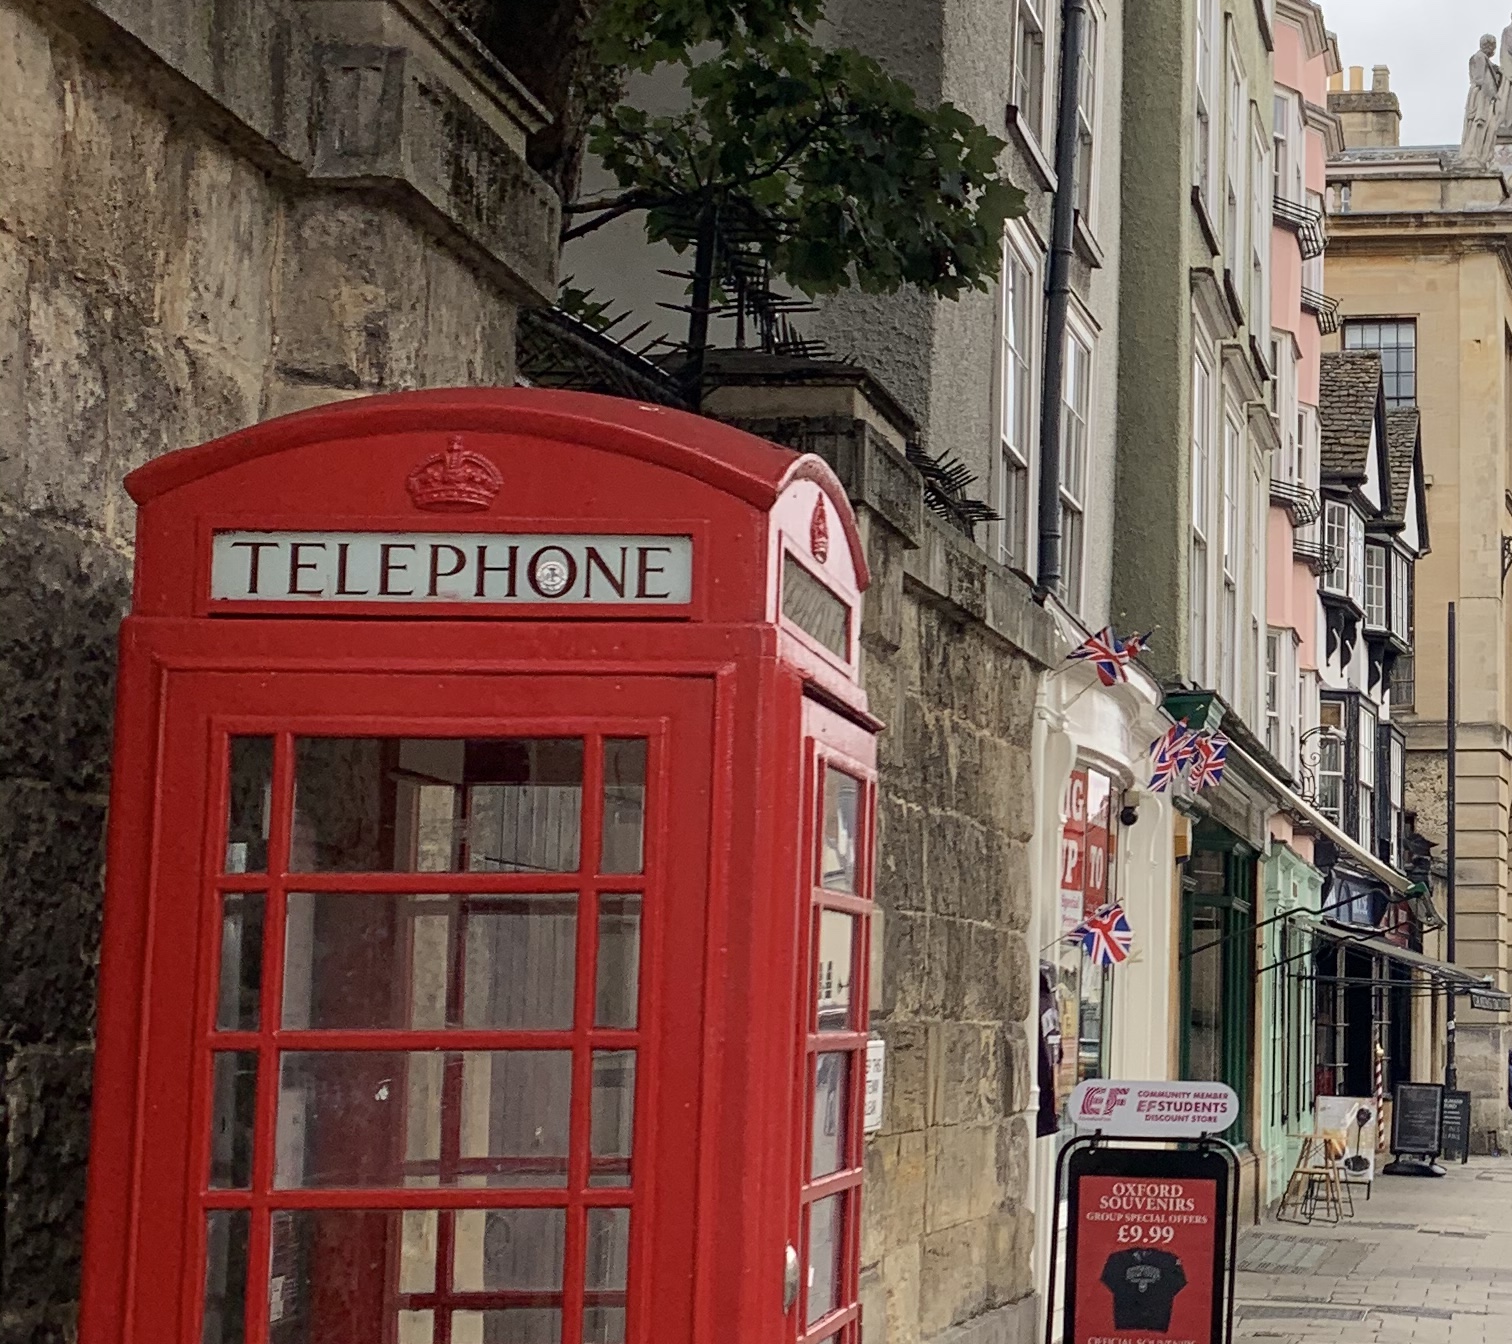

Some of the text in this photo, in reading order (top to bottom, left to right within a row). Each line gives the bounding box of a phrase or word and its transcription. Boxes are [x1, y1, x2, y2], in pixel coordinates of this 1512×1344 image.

[230, 541, 672, 600] TELEPHONE
[1079, 1086, 1130, 1116] EF
[1137, 1090, 1229, 1100] COMMUNITY MEMBER
[1144, 1114, 1218, 1123] DISCOUNT STORE
[1112, 1182, 1183, 1198] OXFORD
[1099, 1195, 1195, 1212] SOUVENIRS
[1086, 1211, 1208, 1225] GROUP SPECIAL OFFERS
[1117, 1224, 1175, 1244] £9.99
